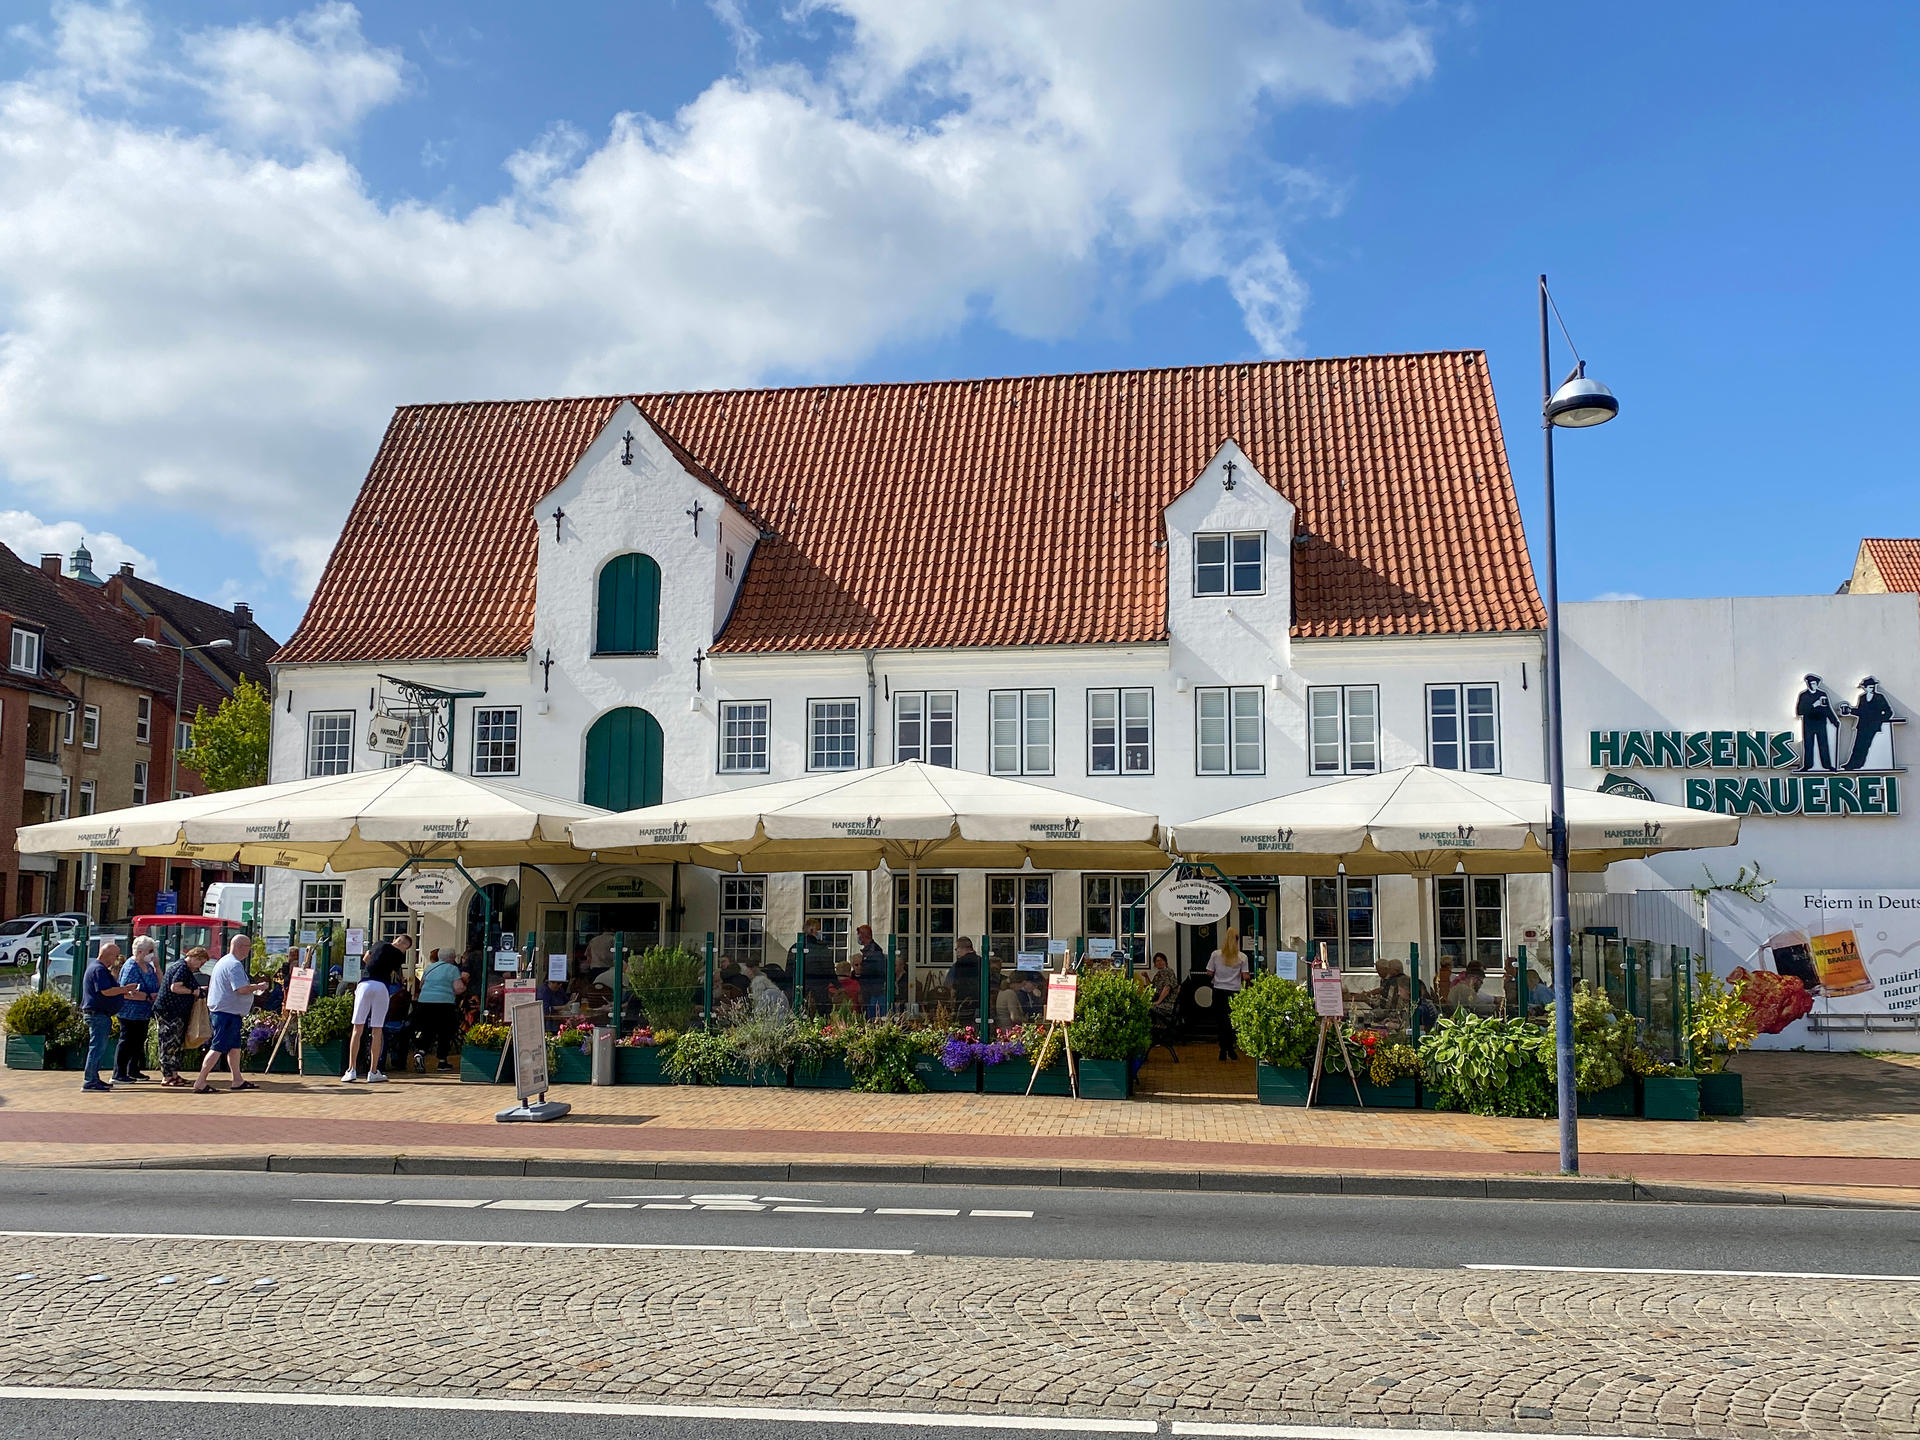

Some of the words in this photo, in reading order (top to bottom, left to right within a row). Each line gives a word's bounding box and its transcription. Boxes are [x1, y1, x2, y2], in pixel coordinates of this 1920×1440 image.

[1589, 730, 1800, 769] HANSENS
[1685, 776, 1900, 816] BRAUEREI
[246, 825, 276, 833] HANSENS
[640, 828, 672, 836] HANSENS
[77, 833, 107, 841] HANSENS
[259, 832, 290, 840] BRAUEREI
[1046, 831, 1080, 839] BRAUEREI
[1604, 829, 1643, 838] HANSENS
[654, 834, 687, 842] BRAUEREI
[1240, 835, 1276, 843] HANSENS
[1623, 837, 1662, 846] BRAUEREI
[1257, 843, 1294, 851] BRAUEREI
[1438, 839, 1475, 847] BRAUEREI
[1804, 895, 1853, 909] Feiern
[1859, 895, 1873, 909] in
[1884, 984, 1920, 998] natur
[1888, 995, 1920, 1010] unge
